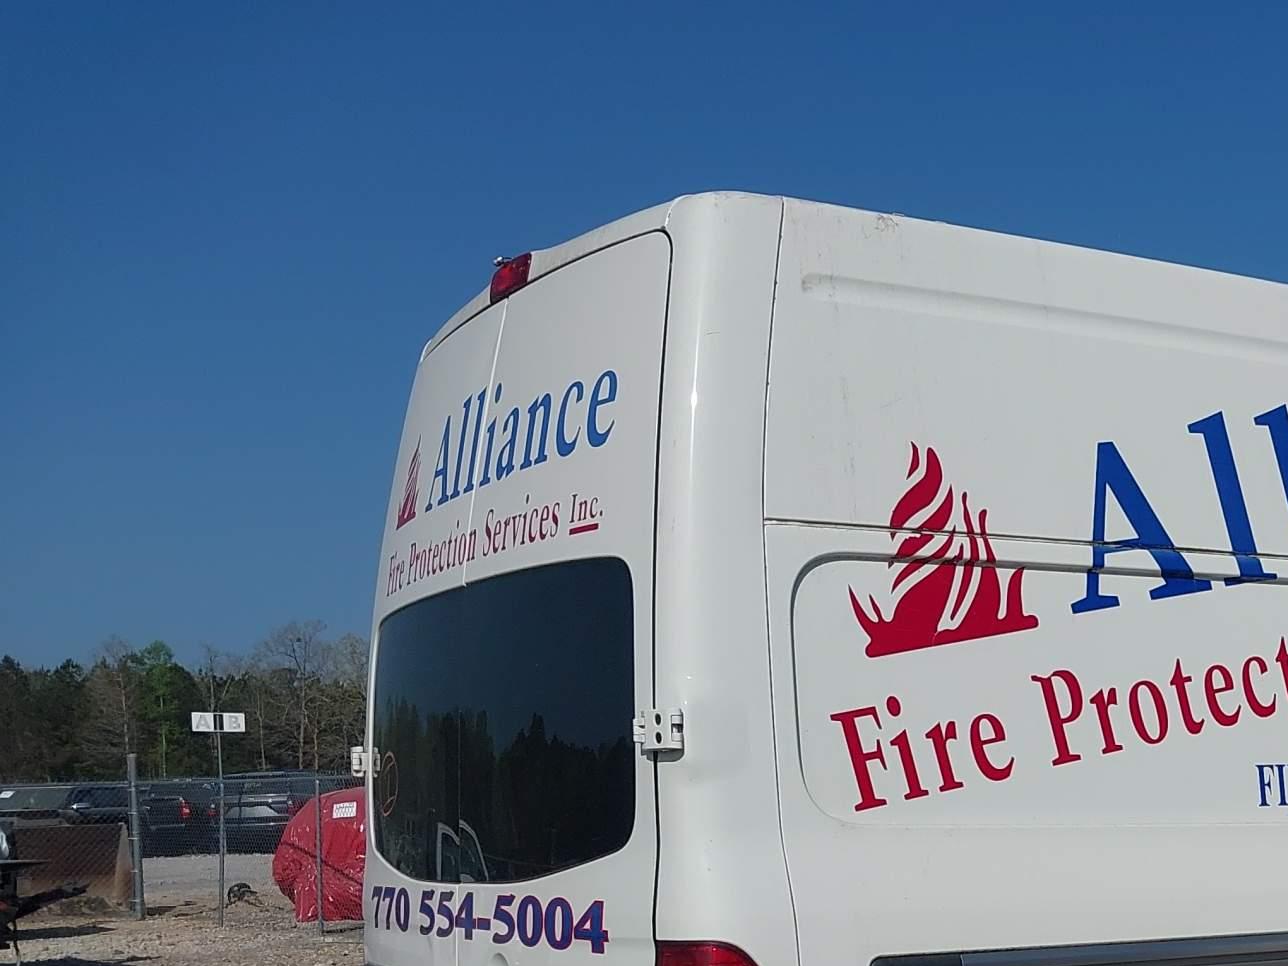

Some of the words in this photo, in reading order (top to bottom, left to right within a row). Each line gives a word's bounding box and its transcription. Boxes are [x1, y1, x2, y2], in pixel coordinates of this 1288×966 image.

[425, 369, 617, 512] Alliance
[386, 550, 405, 597] Fire
[407, 520, 477, 585] Protection
[483, 494, 560, 557] Services
[569, 494, 603, 523] Inc.
[830, 696, 1014, 811] Fire
[371, 886, 410, 932] 770
[419, 889, 609, 954] 554-5004
